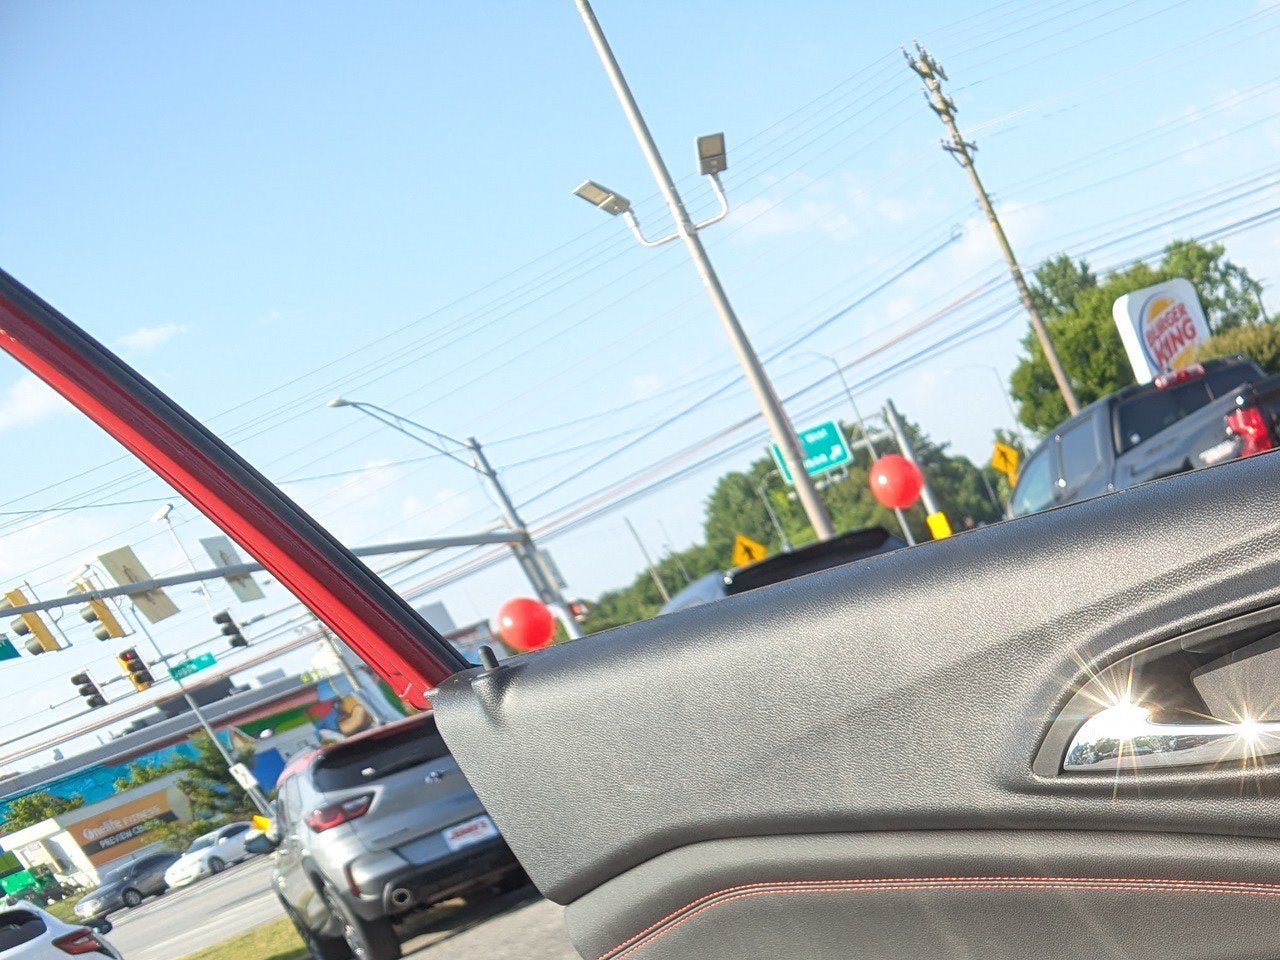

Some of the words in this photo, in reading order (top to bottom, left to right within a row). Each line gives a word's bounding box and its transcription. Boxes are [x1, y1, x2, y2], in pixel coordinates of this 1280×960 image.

[1145, 302, 1188, 348] BURGER
[1153, 317, 1197, 371] KING
[100, 828, 133, 849] PREVIEW
